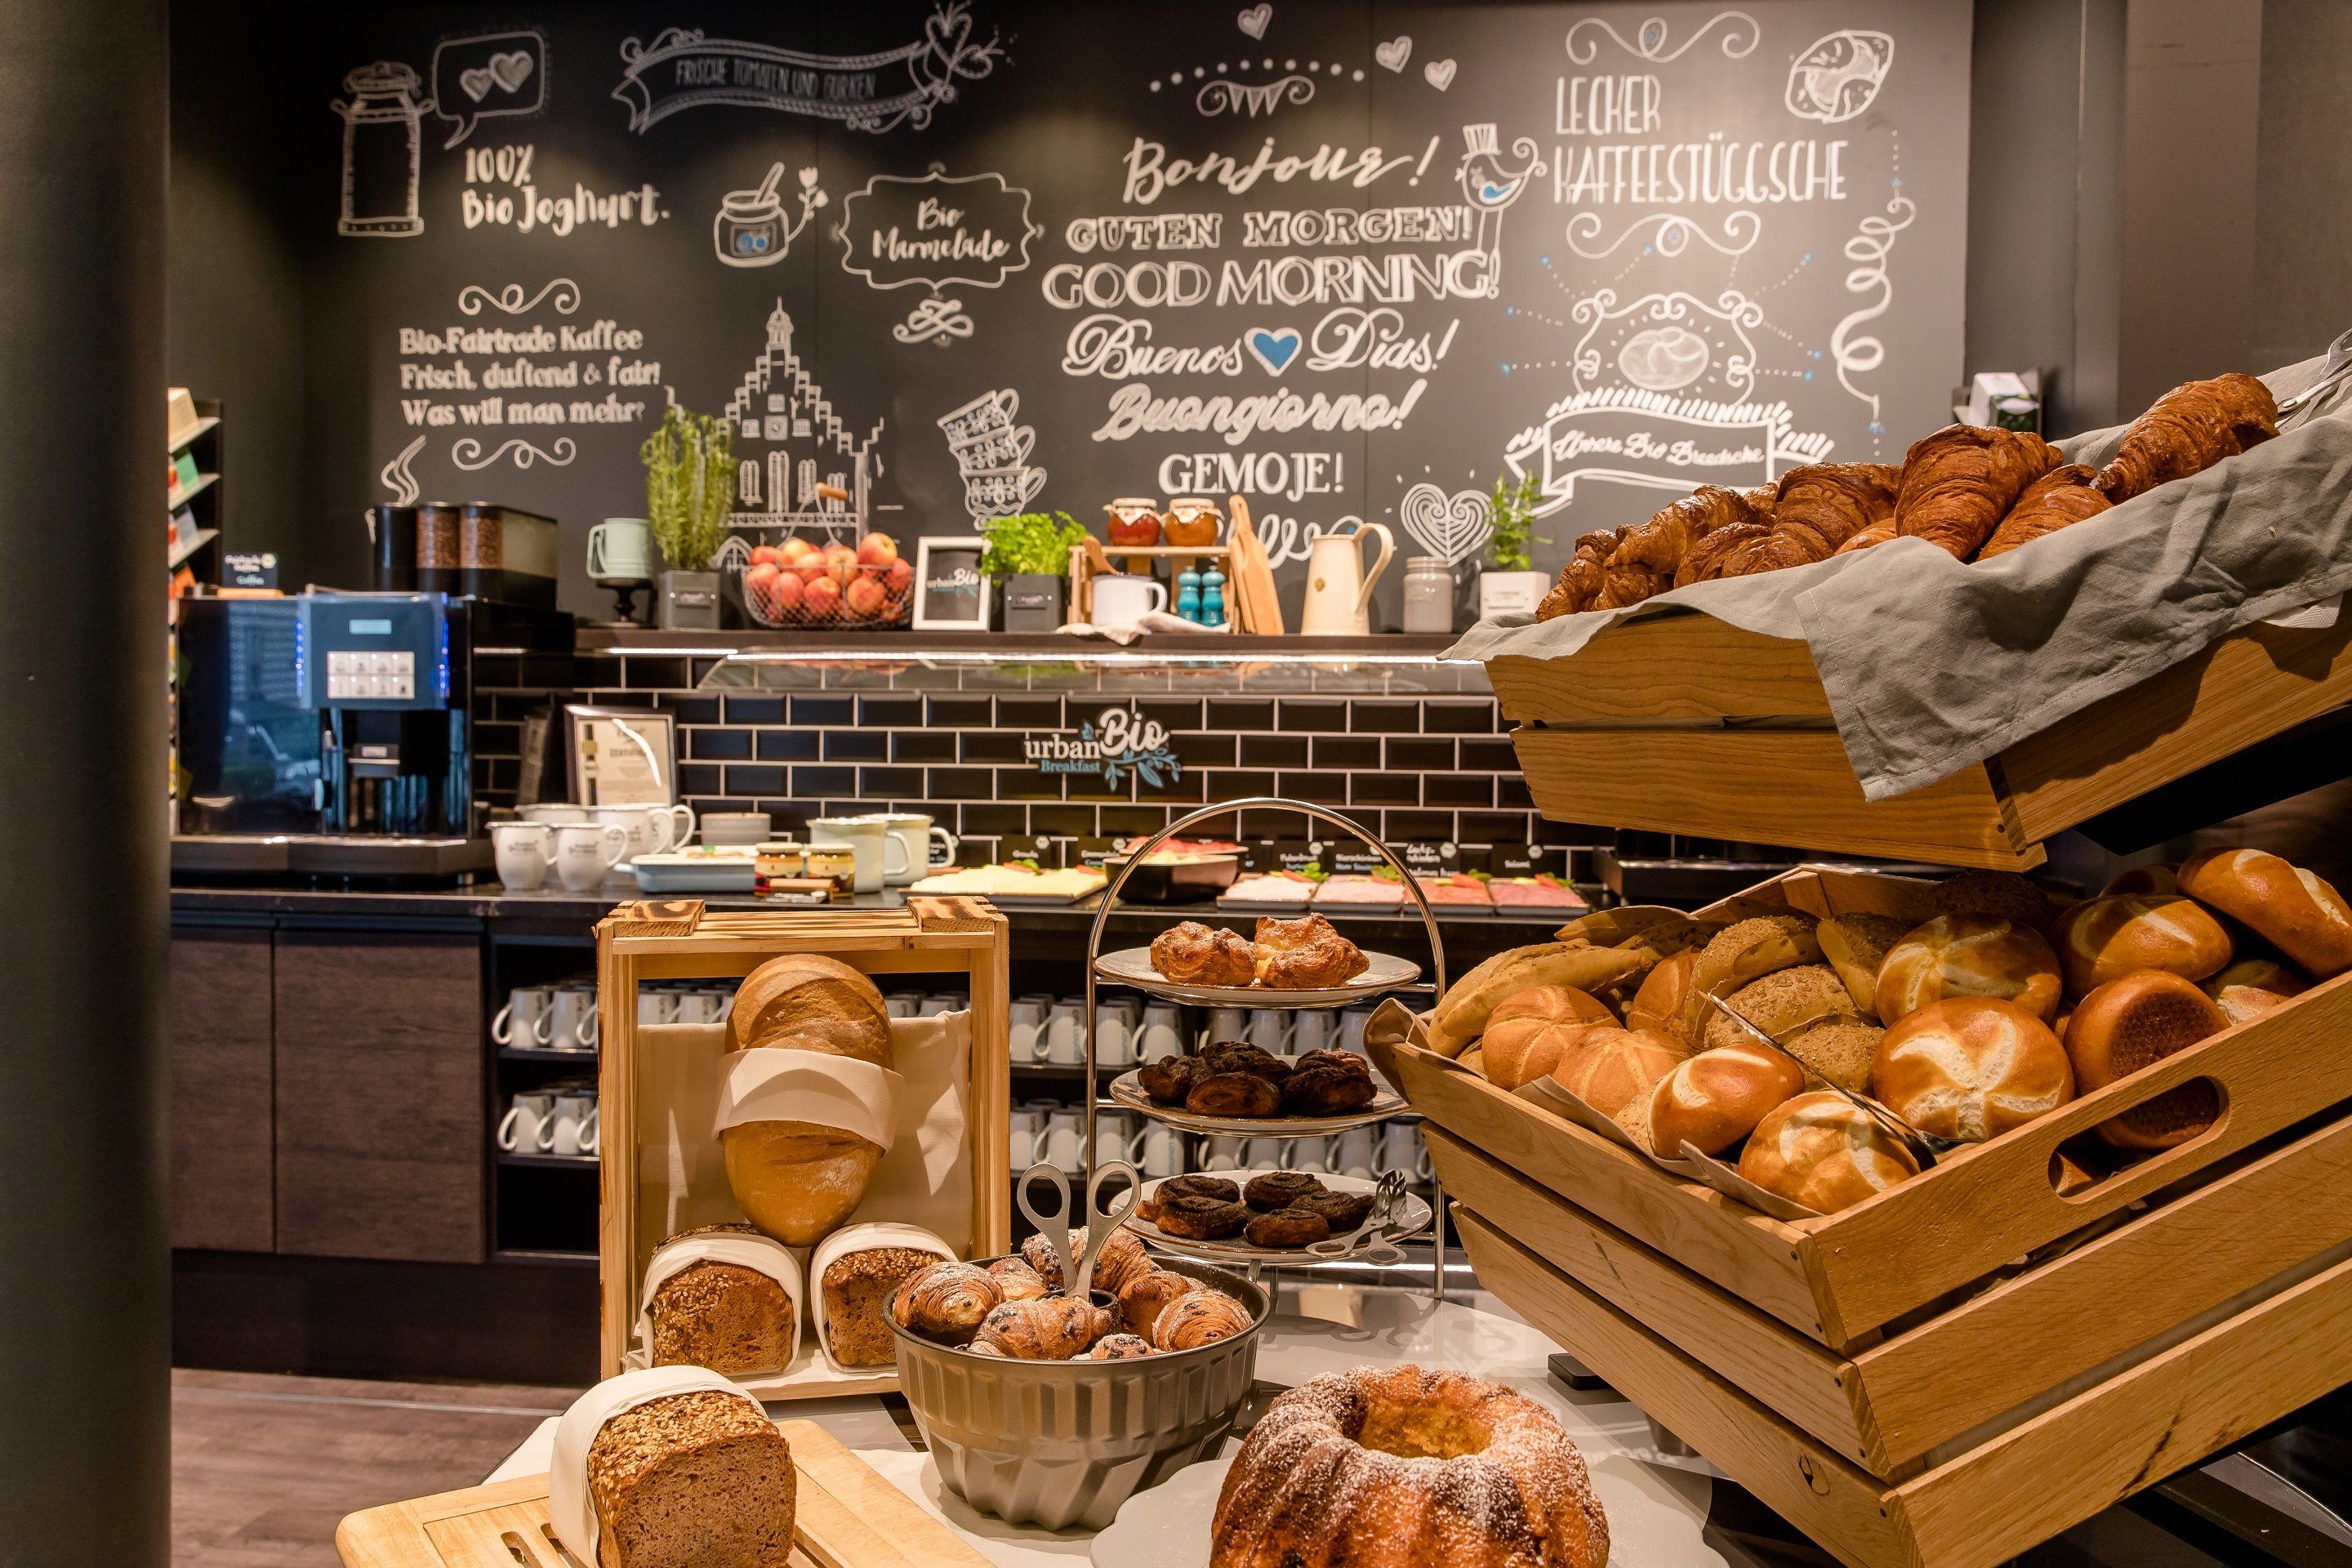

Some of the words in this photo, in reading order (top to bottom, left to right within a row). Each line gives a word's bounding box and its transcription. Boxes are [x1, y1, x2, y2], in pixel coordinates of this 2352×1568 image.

[791, 70, 817, 96] UND
[1555, 74, 1661, 136] LECKER
[465, 144, 534, 187] 100%
[916, 197, 966, 231] Bio
[1066, 212, 1223, 252] GUTEN
[1243, 206, 1472, 247] MORGEN!
[872, 226, 1010, 262] Marmelade
[1041, 261, 1212, 309] GOOD
[1216, 249, 1501, 307] MORNING!
[399, 325, 556, 354] Bio-Fairtrade
[560, 319, 644, 351] Kaffee
[1062, 313, 1244, 380] Buenos
[483, 358, 578, 389] duftend
[582, 363, 602, 385] &
[608, 355, 661, 386] fair!
[401, 399, 456, 426] Was
[458, 397, 503, 425] will
[507, 402, 566, 425] man
[569, 392, 646, 424] mehr?
[1091, 378, 1428, 445] Buongiorno!
[1623, 432, 1668, 460] Bio
[1158, 452, 1343, 501] GEMOJE!
[954, 568, 979, 586] Bio
[1024, 733, 1102, 760] urban
[1099, 708, 1170, 756] Bio
[1040, 760, 1102, 773] Breakfast
